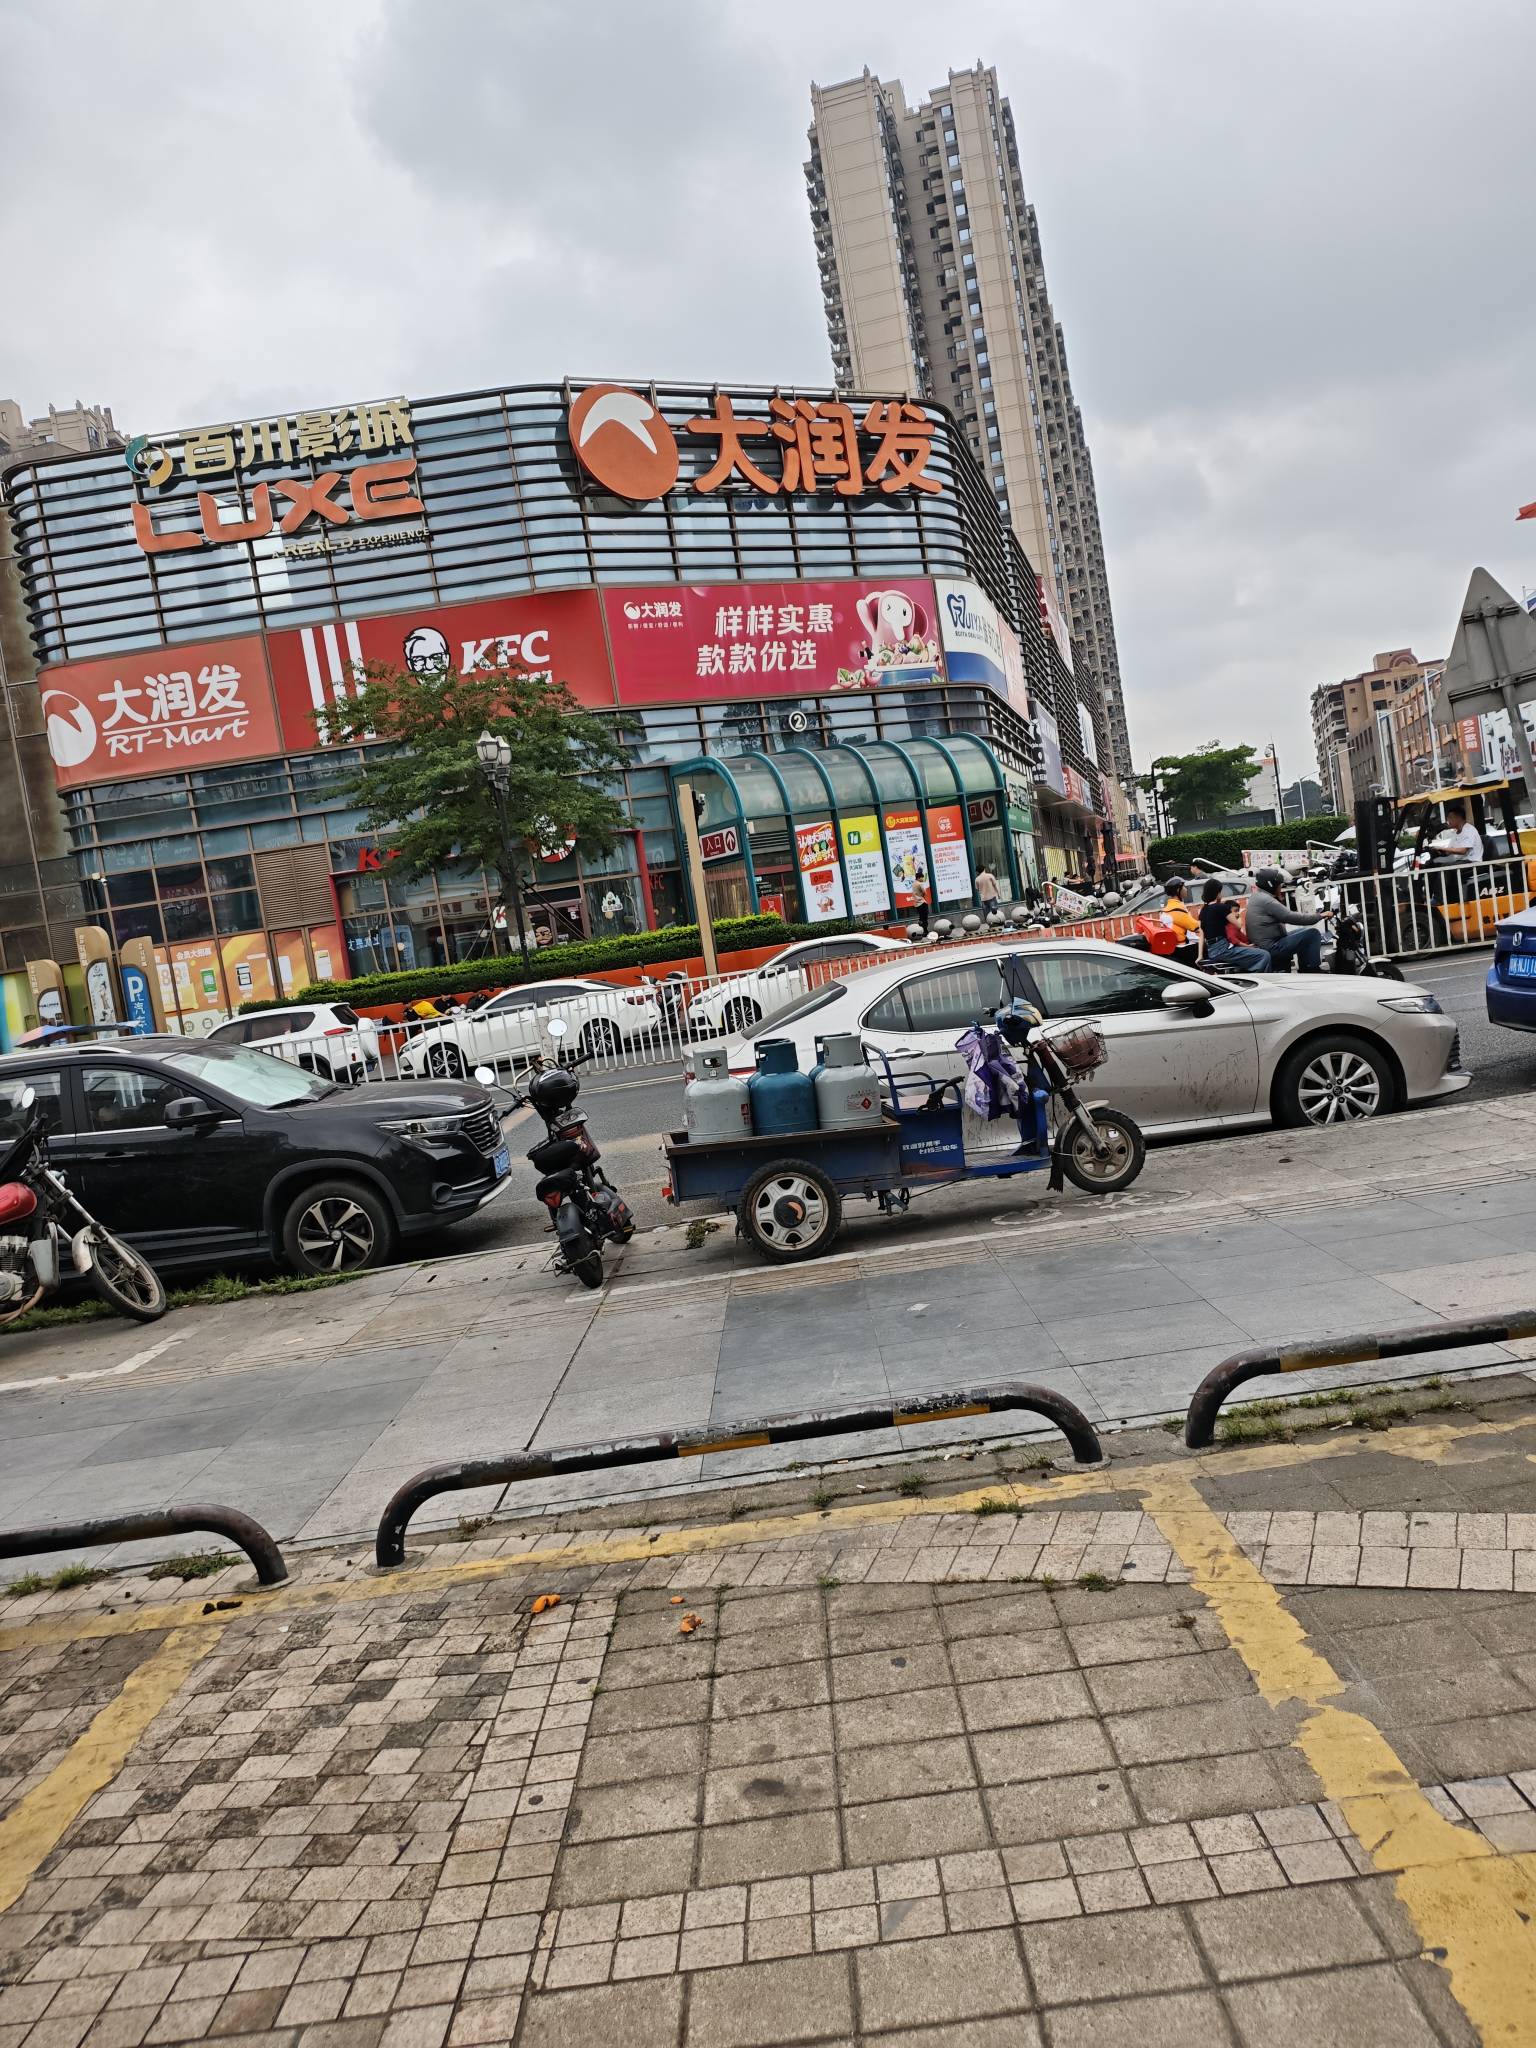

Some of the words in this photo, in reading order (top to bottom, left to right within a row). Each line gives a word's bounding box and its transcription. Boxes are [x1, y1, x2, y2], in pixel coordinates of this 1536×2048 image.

[179, 399, 415, 477] 百川影城
[685, 395, 942, 496] 大润发
[131, 459, 425, 553] LUXE
[359, 527, 431, 546] EXPERIENCE
[641, 602, 683, 618] 大润发
[715, 603, 834, 638] 样样实惠
[460, 630, 550, 675] KFC
[696, 638, 817, 677] 款款优选
[98, 664, 246, 730] 大润发
[106, 718, 249, 758] RT-Mart
[706, 836, 722, 852] 入口
[127, 975, 144, 1003] P
